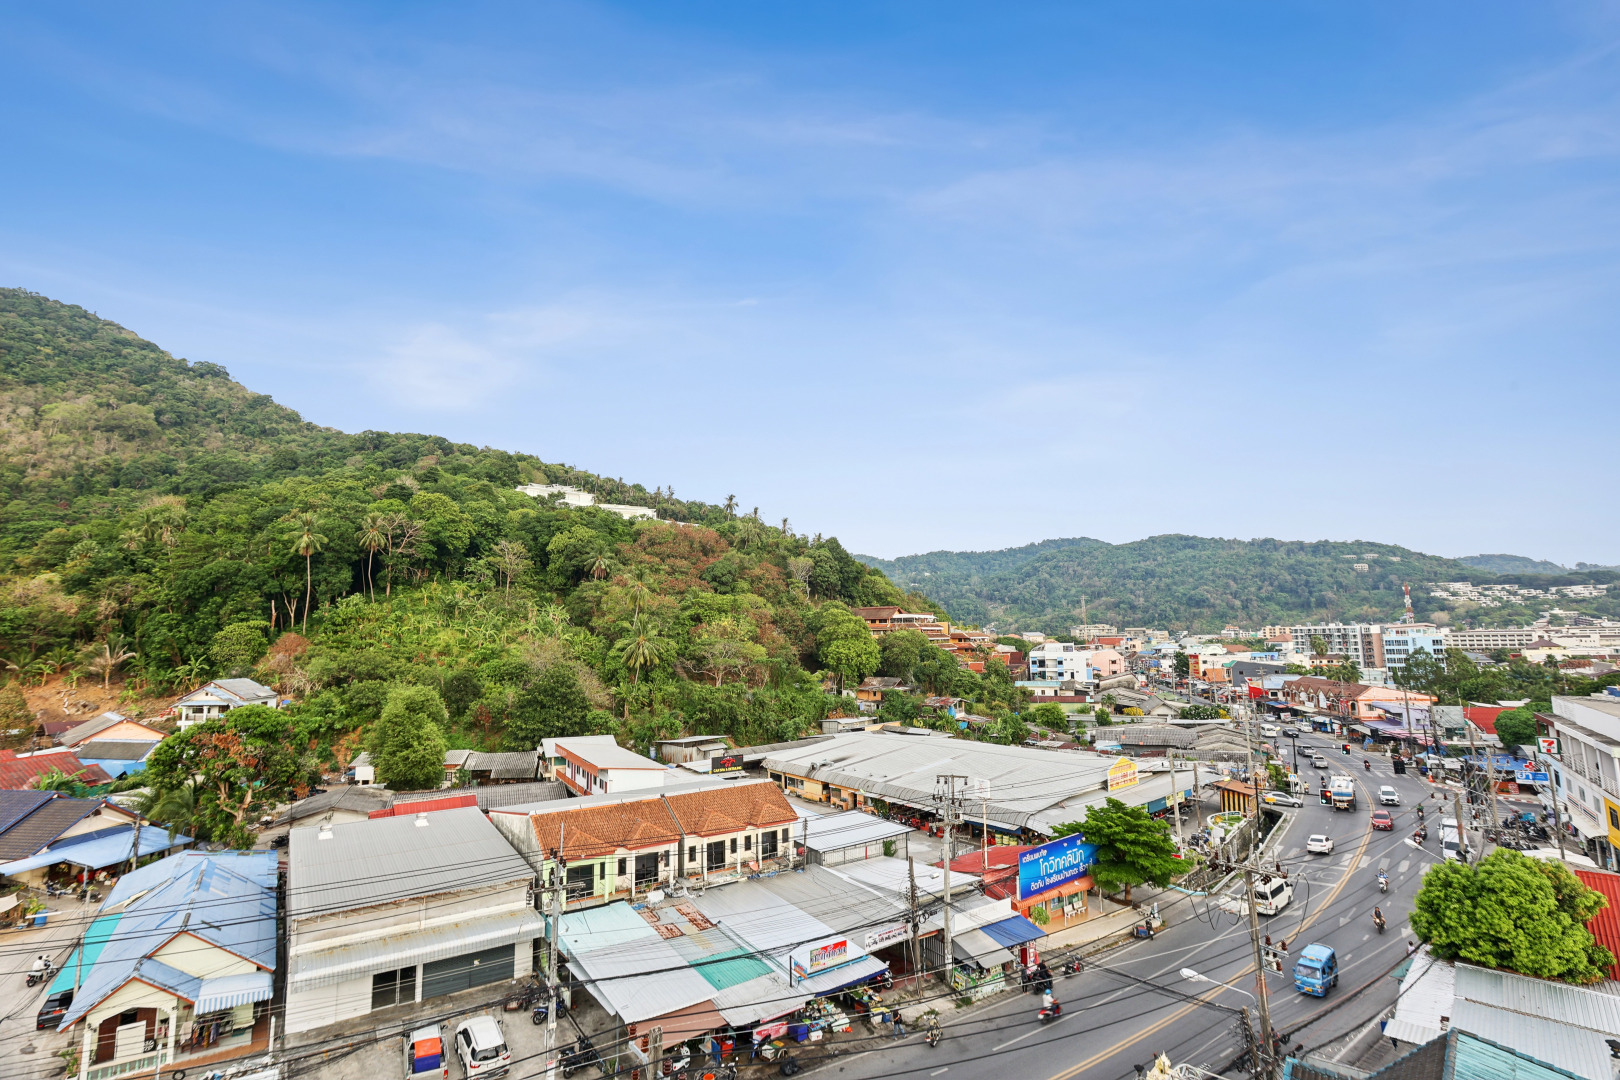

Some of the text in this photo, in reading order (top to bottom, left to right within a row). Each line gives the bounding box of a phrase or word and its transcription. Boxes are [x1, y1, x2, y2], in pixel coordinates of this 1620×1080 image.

[1039, 848, 1085, 876] โกวิทคลินิก
